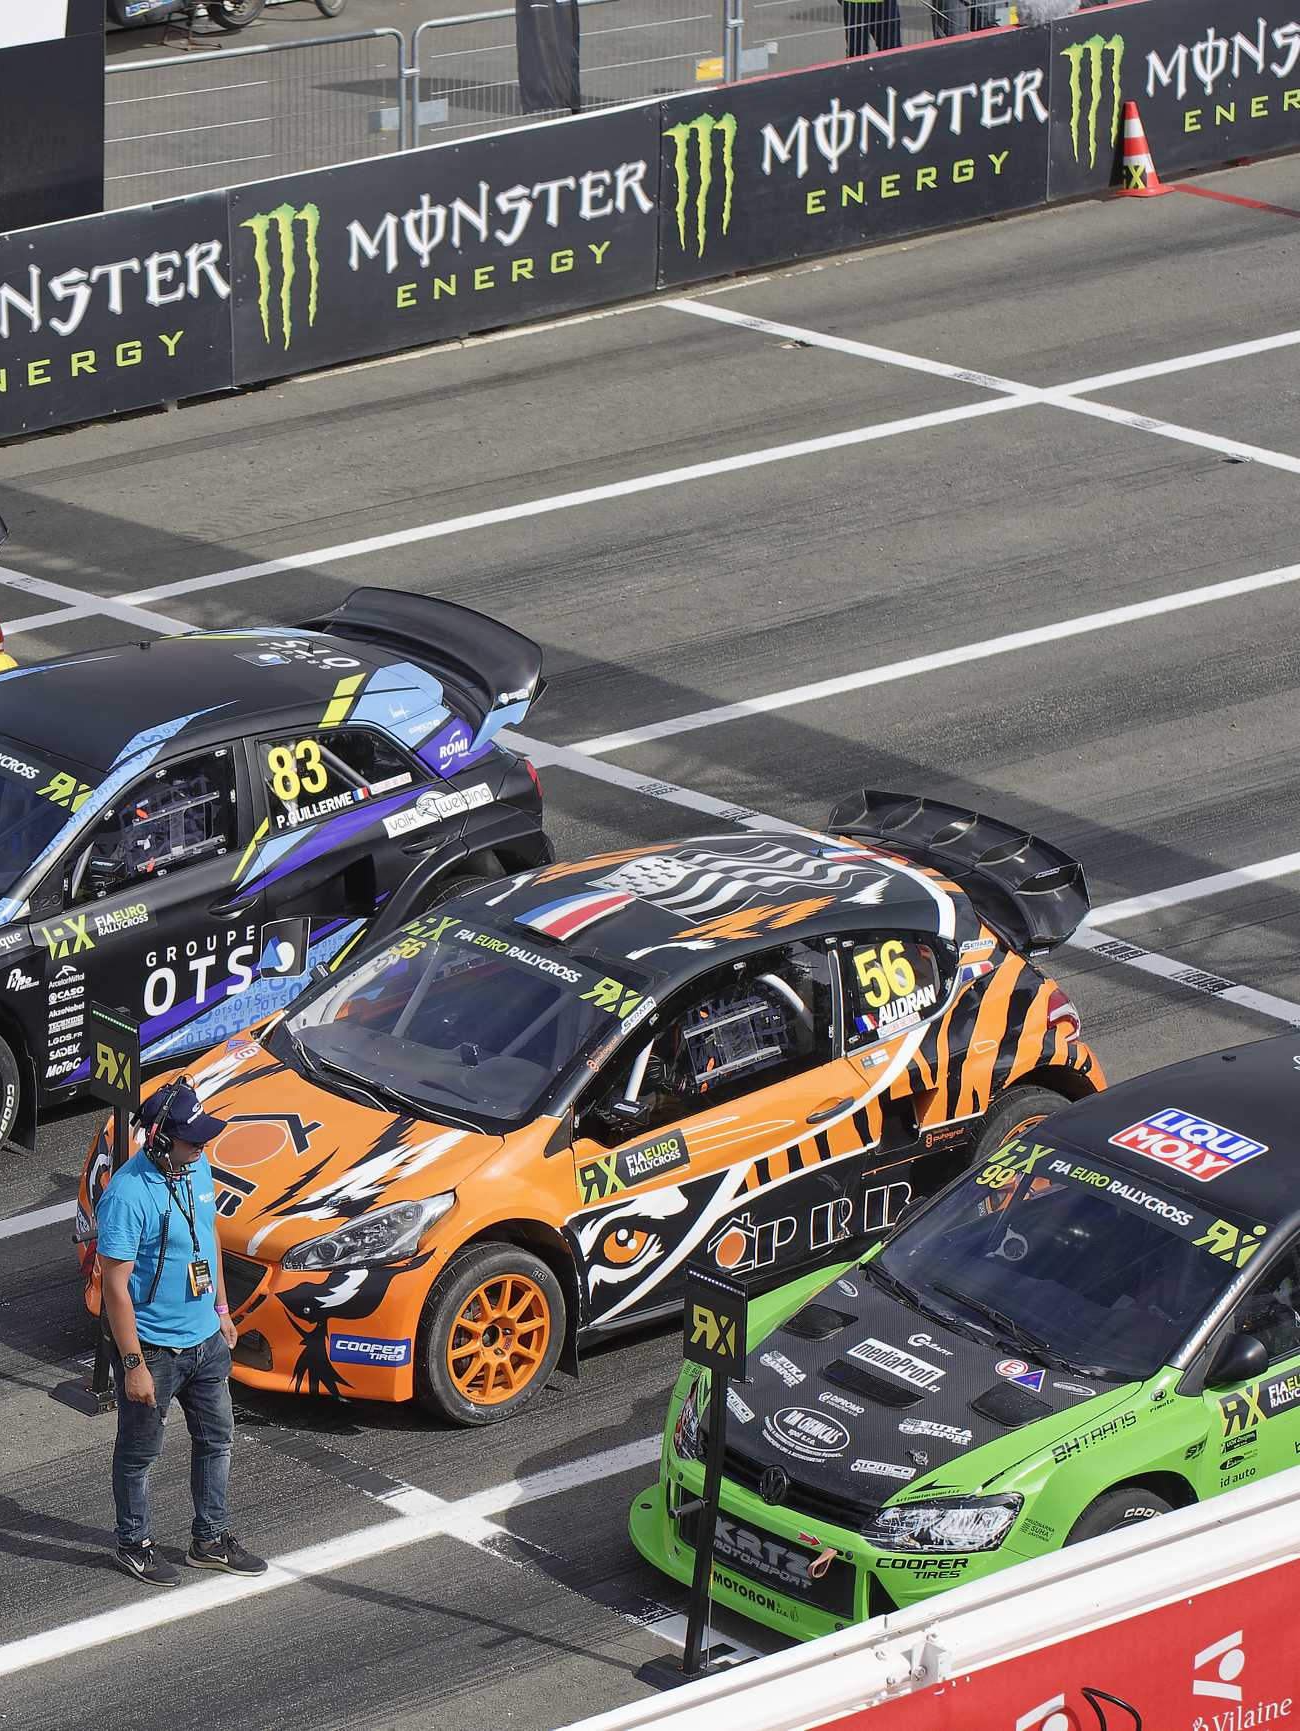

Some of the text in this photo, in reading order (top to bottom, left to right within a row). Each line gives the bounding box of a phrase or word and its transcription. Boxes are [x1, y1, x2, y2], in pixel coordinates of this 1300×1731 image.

[760, 67, 1049, 179] MONSTER
[806, 150, 1010, 216] ENERGY
[347, 159, 654, 273] MONSTER
[396, 241, 611, 309] ENERGY
[440, 738, 468, 759] ROMI
[267, 740, 328, 800] 83
[276, 791, 353, 829] P.GUILLERME
[438, 786, 493, 813] welding
[97, 913, 149, 937] RALLYCROSS
[146, 925, 256, 967] GROUPE
[454, 928, 582, 983] FIA EURO RALLYCROSS
[854, 940, 916, 1008] 56
[143, 945, 254, 1017] OTS
[878, 984, 937, 1027] AUDRAN
[1119, 1130, 1233, 1174] MOLY
[1150, 1110, 1258, 1160] LIQUI
[628, 1149, 681, 1177] RALLYCROSS
[976, 1164, 1016, 1189] 99
[1048, 1159, 1194, 1227] FIA EURO RALLYCROSS
[336, 1339, 408, 1356] COOPER
[369, 1352, 403, 1361] TIRES
[800, 1415, 844, 1445] CHEMICALS
[1220, 1467, 1257, 1488] id auto
[713, 1540, 813, 1588] MOTORSPORT
[876, 1557, 969, 1571] COOPER
[914, 1569, 961, 1579] TIRES
[713, 1570, 776, 1612] MOTORON
